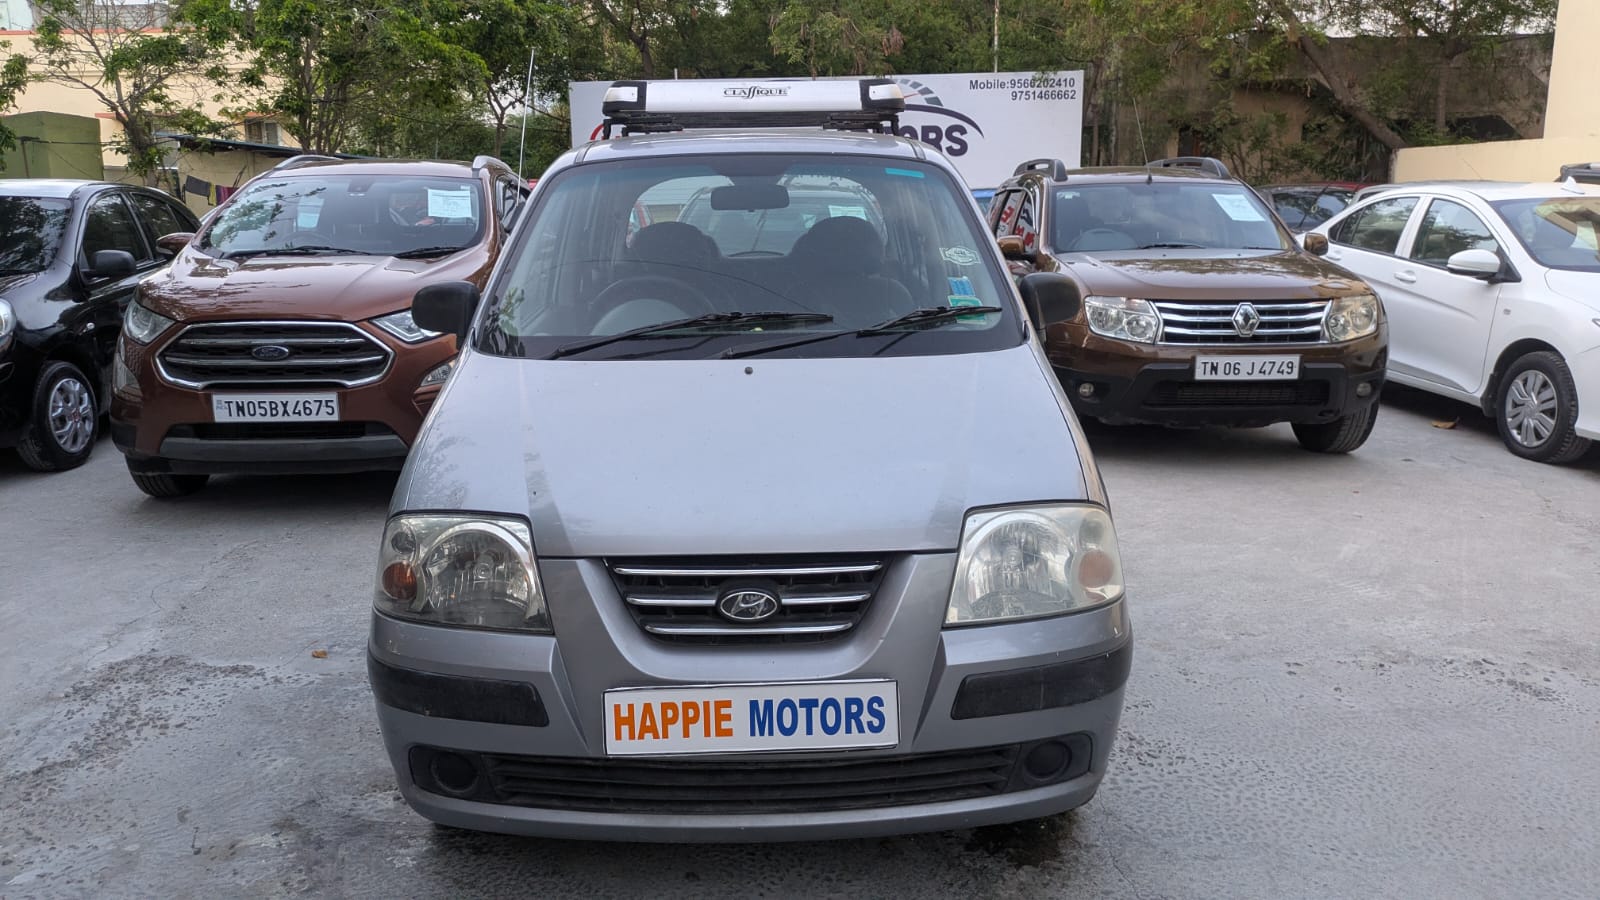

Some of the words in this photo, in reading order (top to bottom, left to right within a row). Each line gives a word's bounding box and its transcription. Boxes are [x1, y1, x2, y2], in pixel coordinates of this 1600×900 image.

[1010, 89, 1076, 101] 9751466662
[1201, 362, 1219, 376] TN
[1223, 361, 1241, 376] 06
[1246, 362, 1255, 376] J
[1258, 361, 1294, 375] 4749
[224, 400, 335, 417] TN05BX4675
[613, 700, 733, 741] HAPPIE
[749, 695, 886, 737] MOTORS
